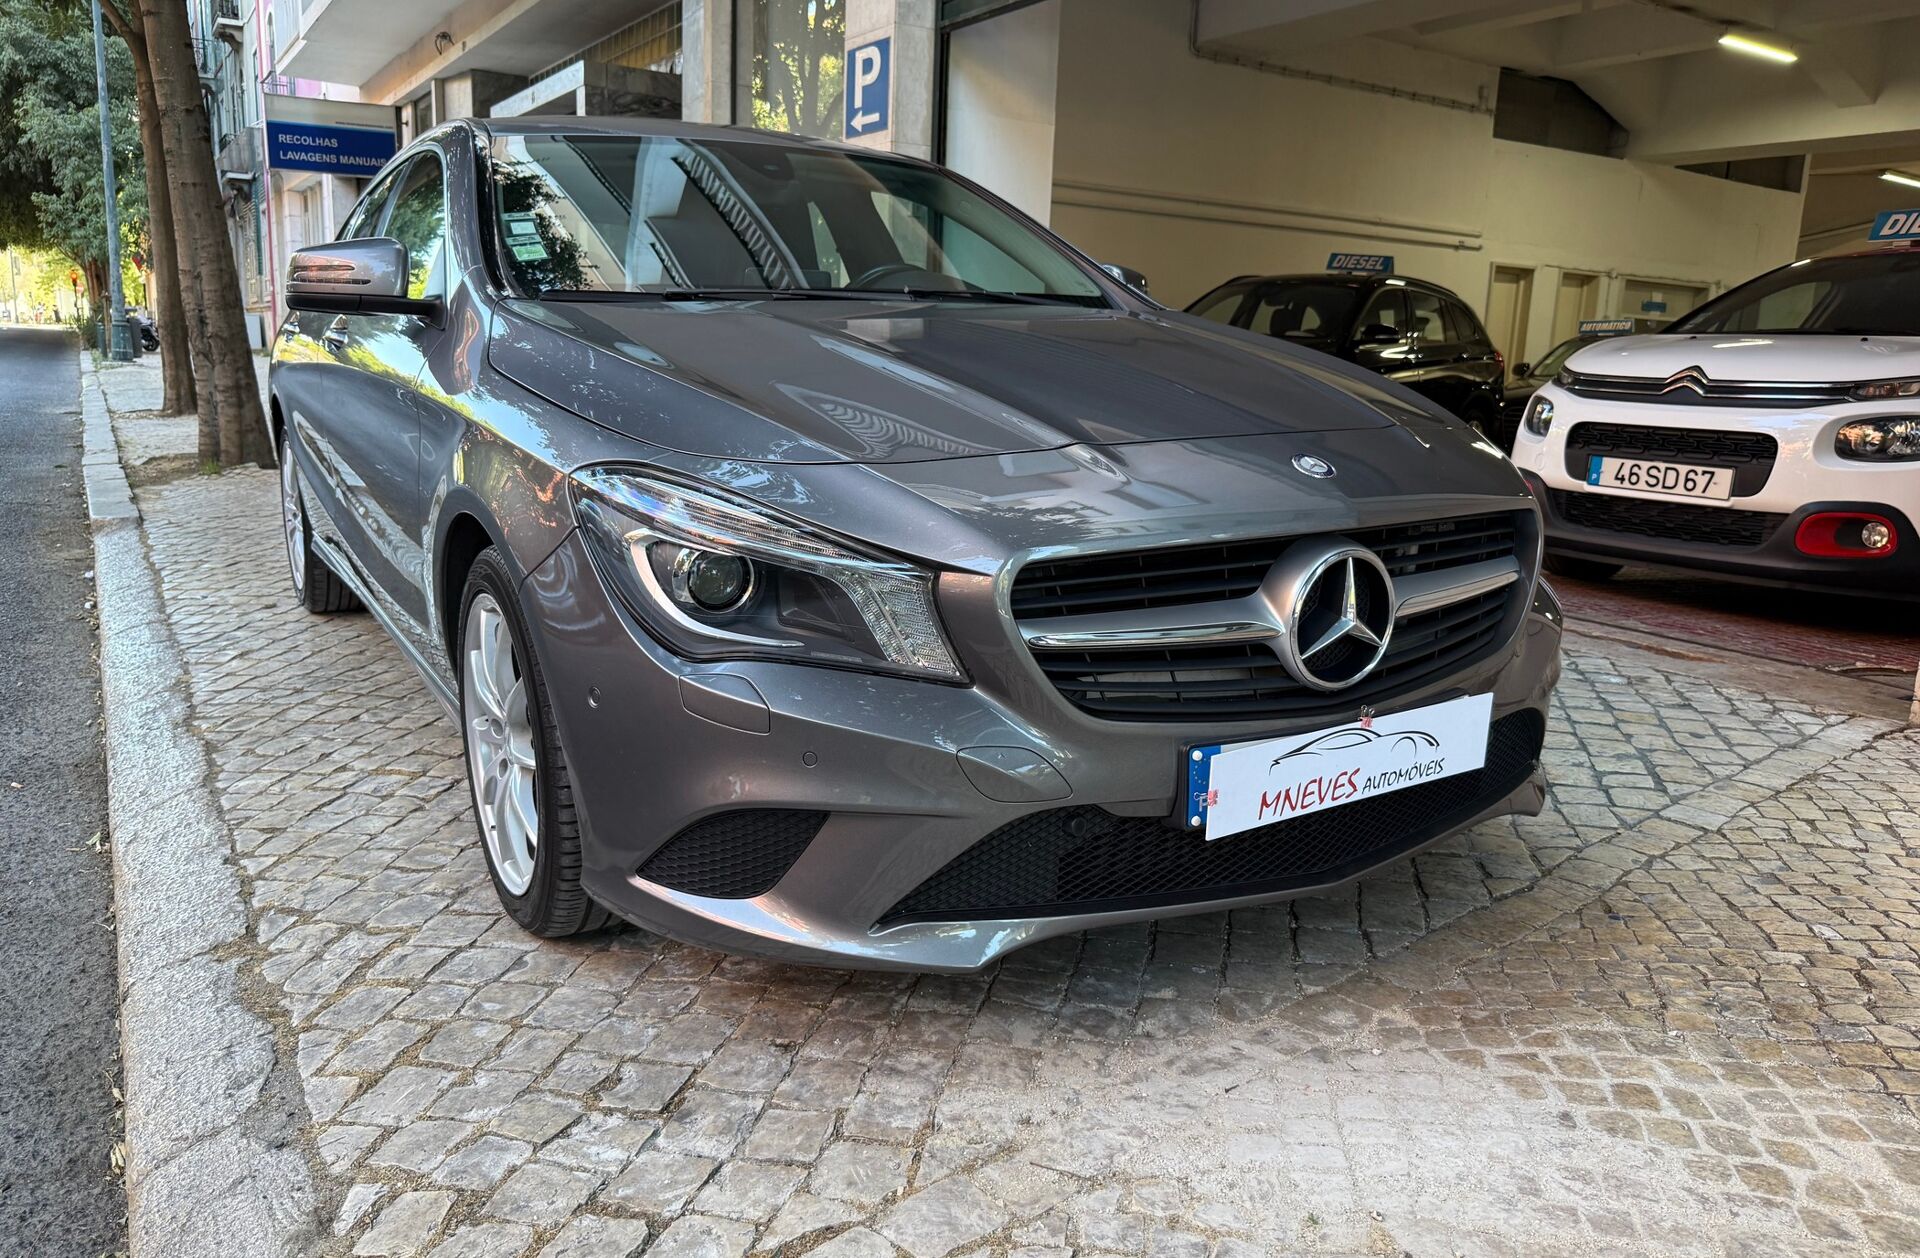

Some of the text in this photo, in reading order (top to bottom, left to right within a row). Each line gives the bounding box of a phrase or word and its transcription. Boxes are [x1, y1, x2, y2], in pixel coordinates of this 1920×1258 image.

[854, 46, 881, 109] P
[278, 133, 338, 148] RECOLHAS
[280, 150, 337, 163] LAVAGENS
[1331, 255, 1384, 270] DIESEL
[1258, 757, 1445, 820] MNEVES AUTOMÓVEIS
